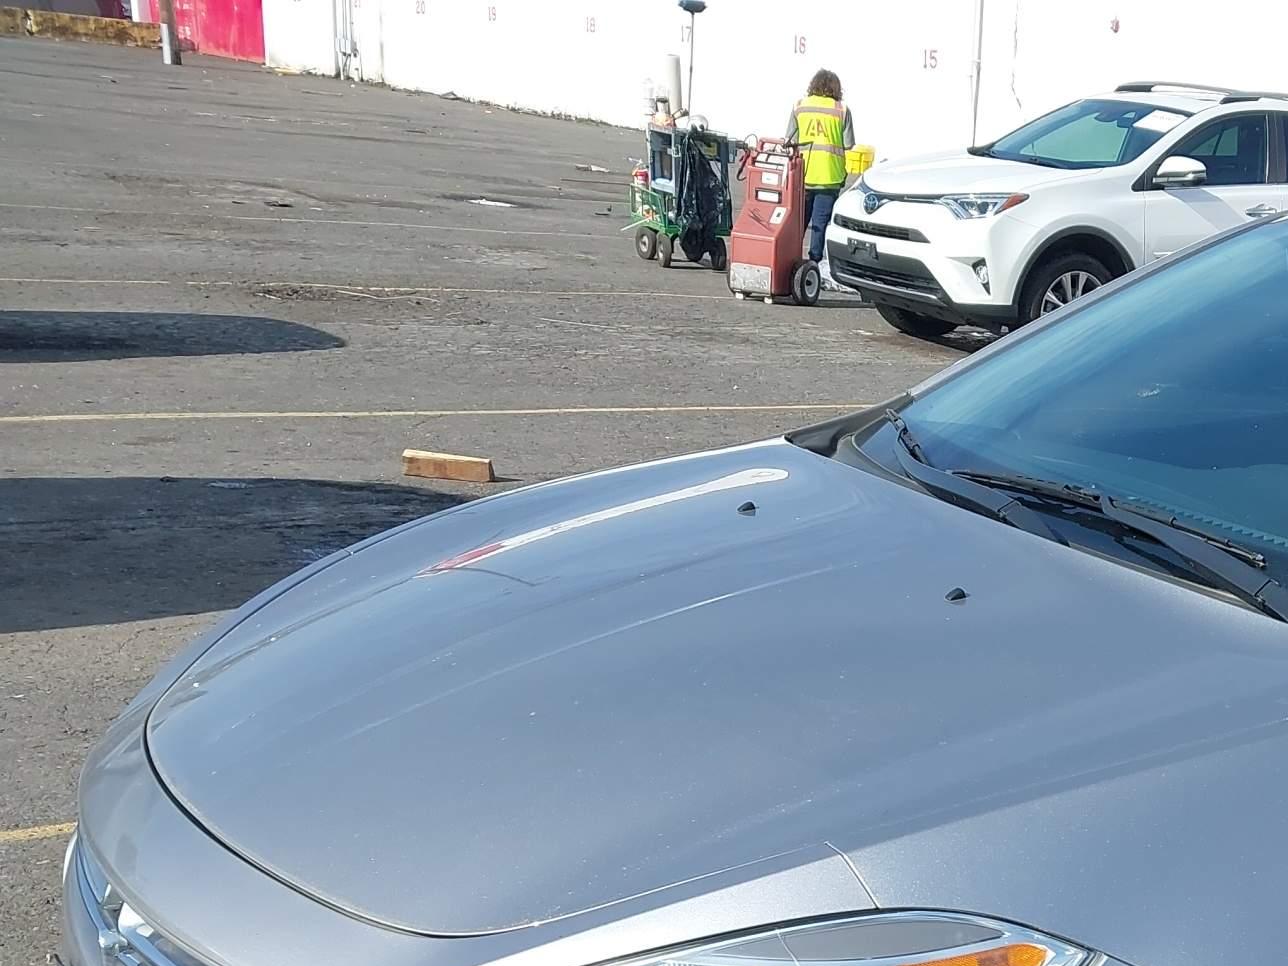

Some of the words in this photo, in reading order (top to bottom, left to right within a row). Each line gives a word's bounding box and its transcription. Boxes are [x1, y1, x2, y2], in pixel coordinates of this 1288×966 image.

[487, 6, 497, 22] 19
[681, 25, 692, 43] 17
[793, 35, 807, 54] 16
[923, 48, 938, 69] 15
